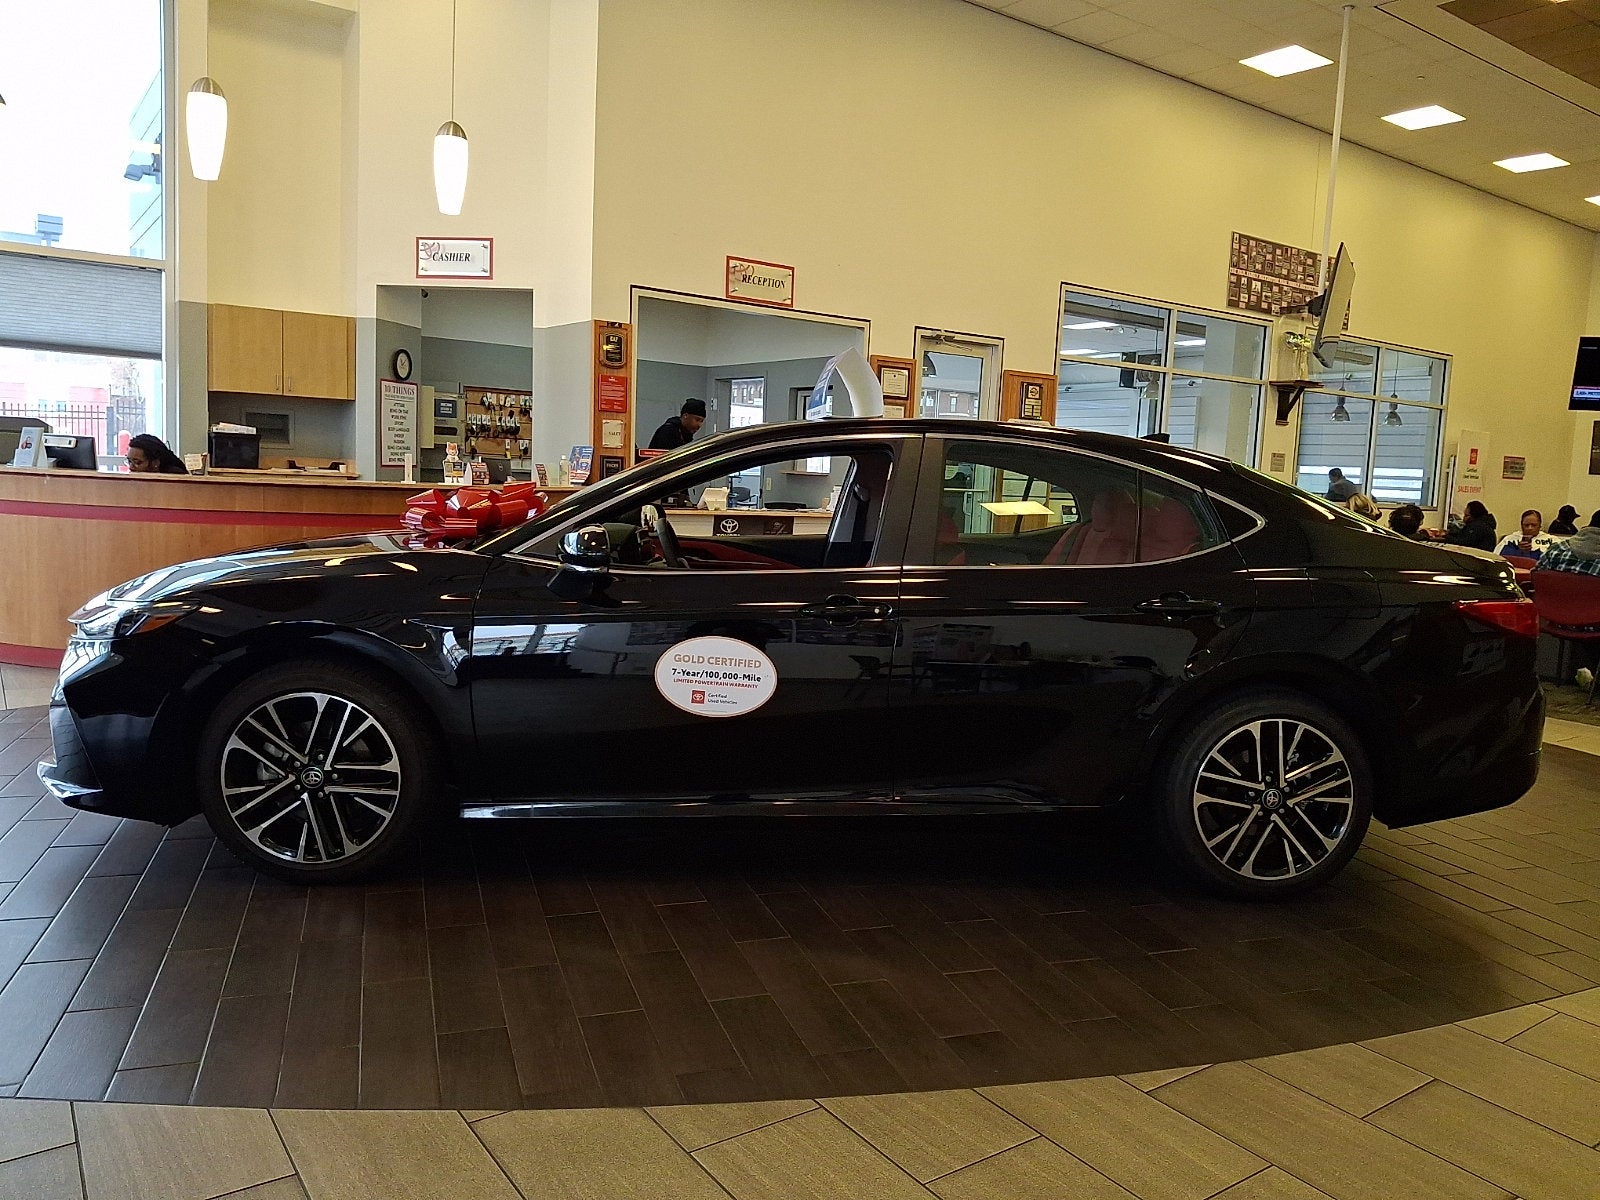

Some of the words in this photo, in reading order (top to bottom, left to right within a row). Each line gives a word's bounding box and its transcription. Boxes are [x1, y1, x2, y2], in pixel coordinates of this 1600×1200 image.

[432, 252, 471, 262] CASHIER
[742, 274, 786, 288] RECEPTION
[392, 386, 414, 396] THINGS
[674, 654, 705, 664] GOLD
[707, 657, 761, 668] CERTIFIED
[671, 668, 762, 682] 7-Year/100,000-Mile
[694, 679, 729, 687] POWERTRAIN
